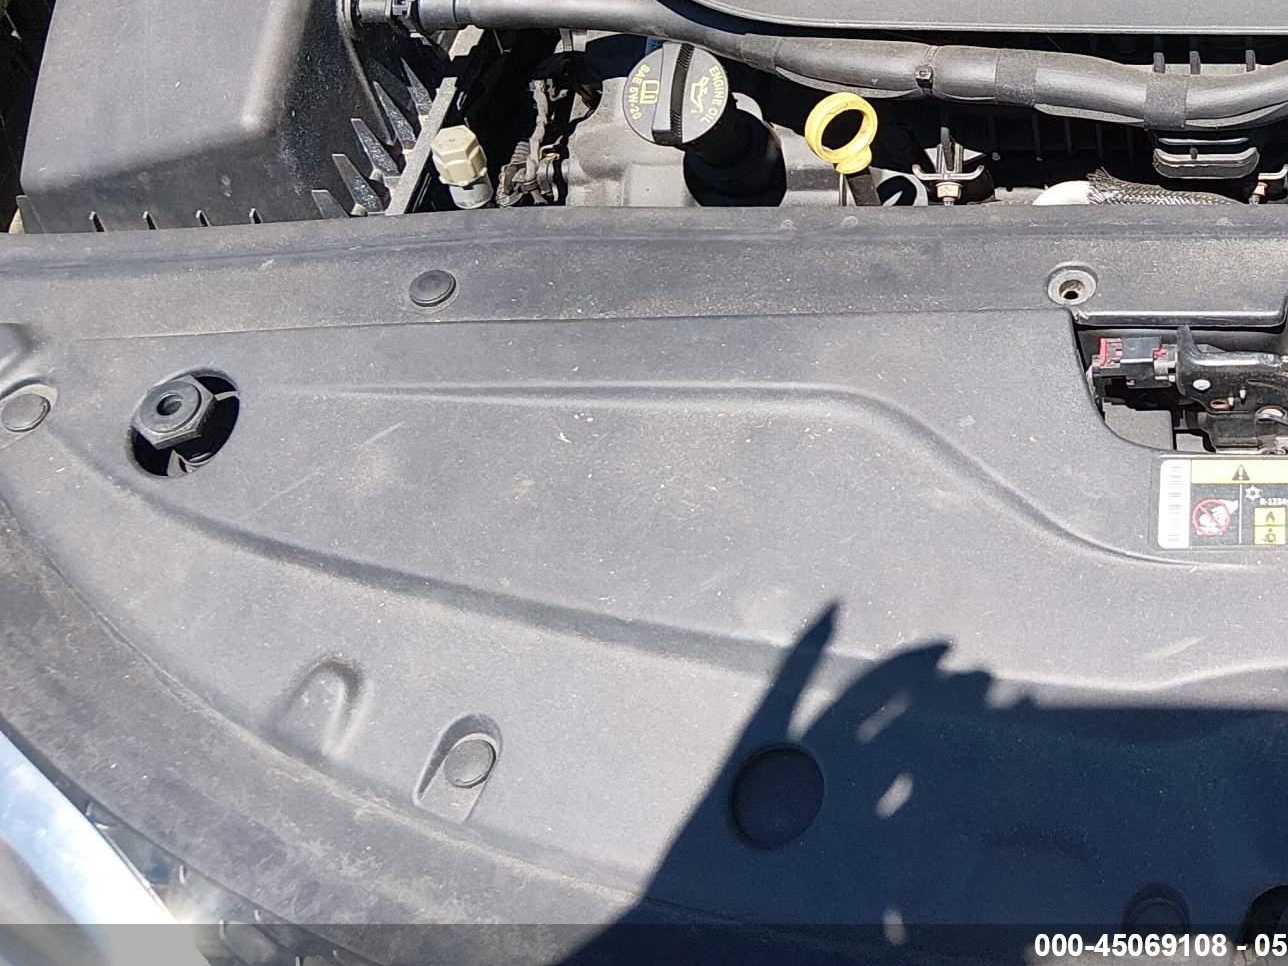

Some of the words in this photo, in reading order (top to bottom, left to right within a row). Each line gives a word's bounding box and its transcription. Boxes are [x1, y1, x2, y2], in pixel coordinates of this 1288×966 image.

[631, 64, 651, 85] SAE
[709, 65, 725, 107] ENGINE
[699, 108, 719, 124] OIL
